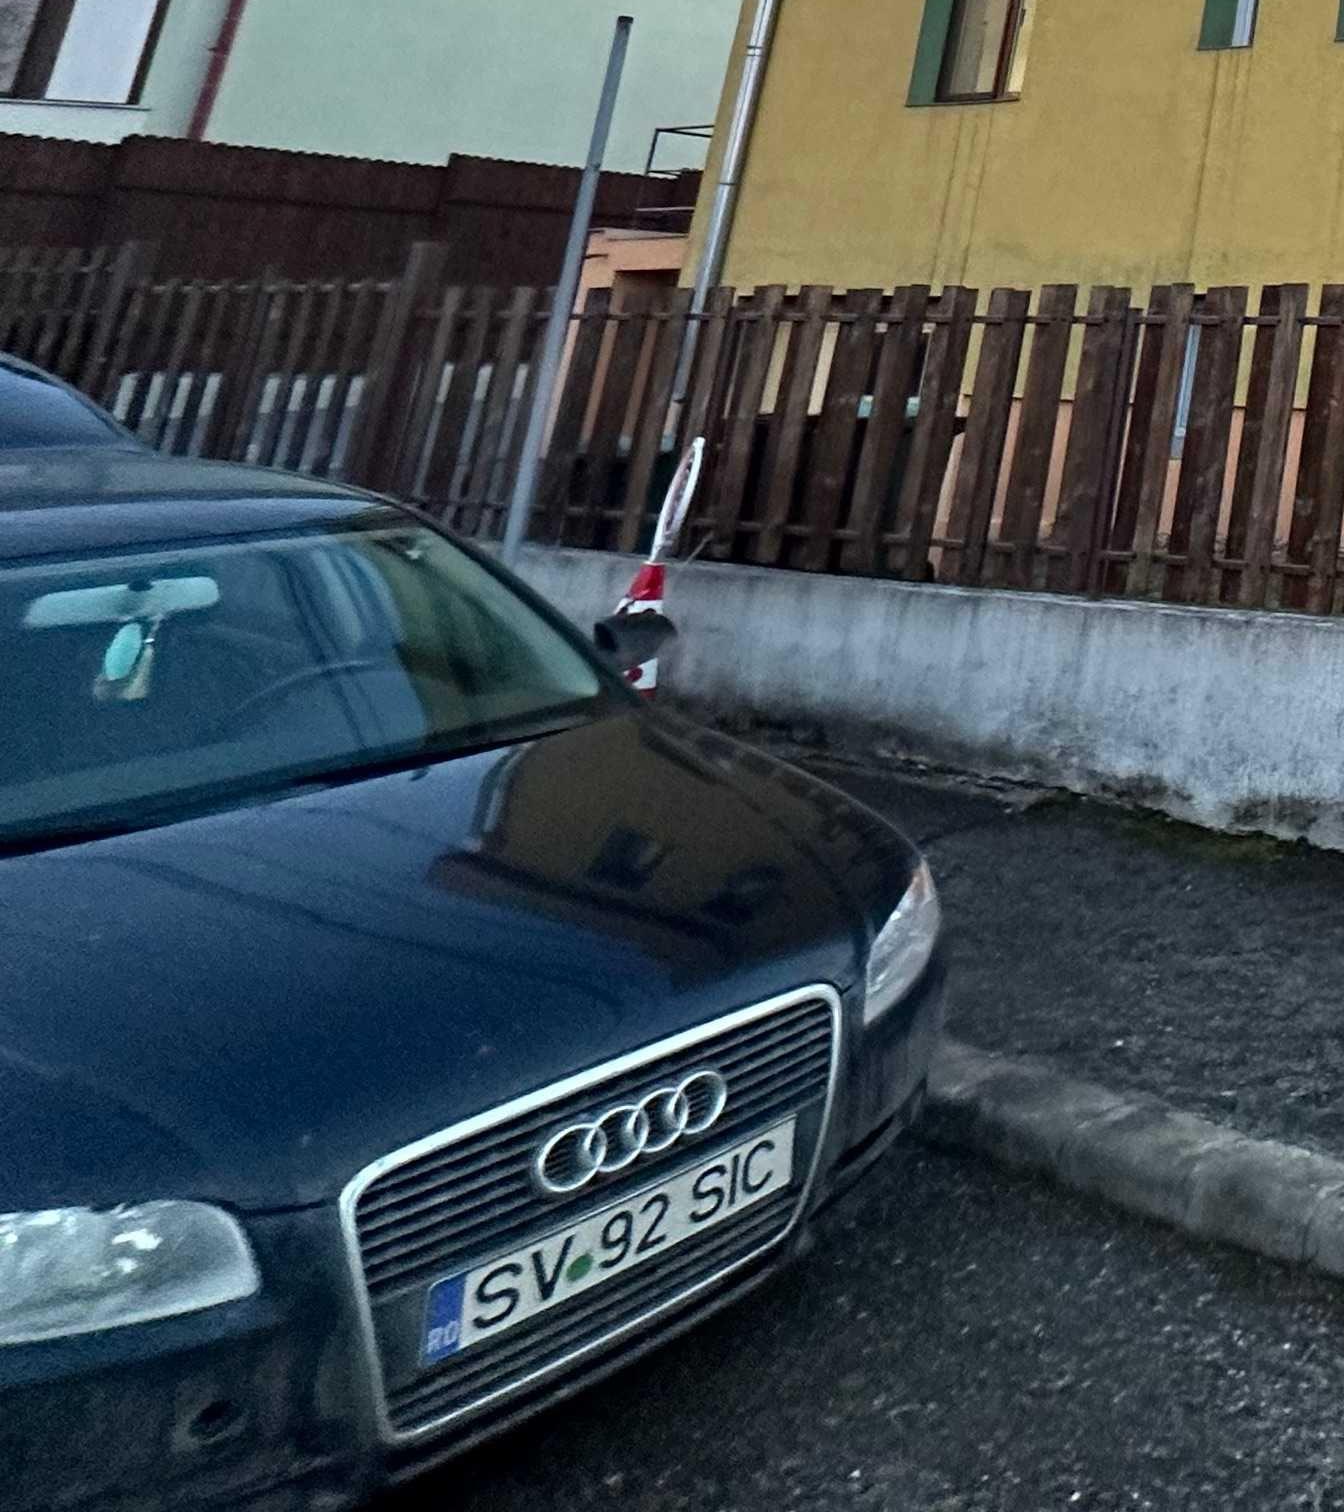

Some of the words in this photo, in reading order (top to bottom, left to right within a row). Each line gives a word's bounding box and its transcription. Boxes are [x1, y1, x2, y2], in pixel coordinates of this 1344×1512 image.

[472, 1234, 575, 1329] SV
[597, 1192, 670, 1270] 92
[688, 1139, 776, 1224] SIC
